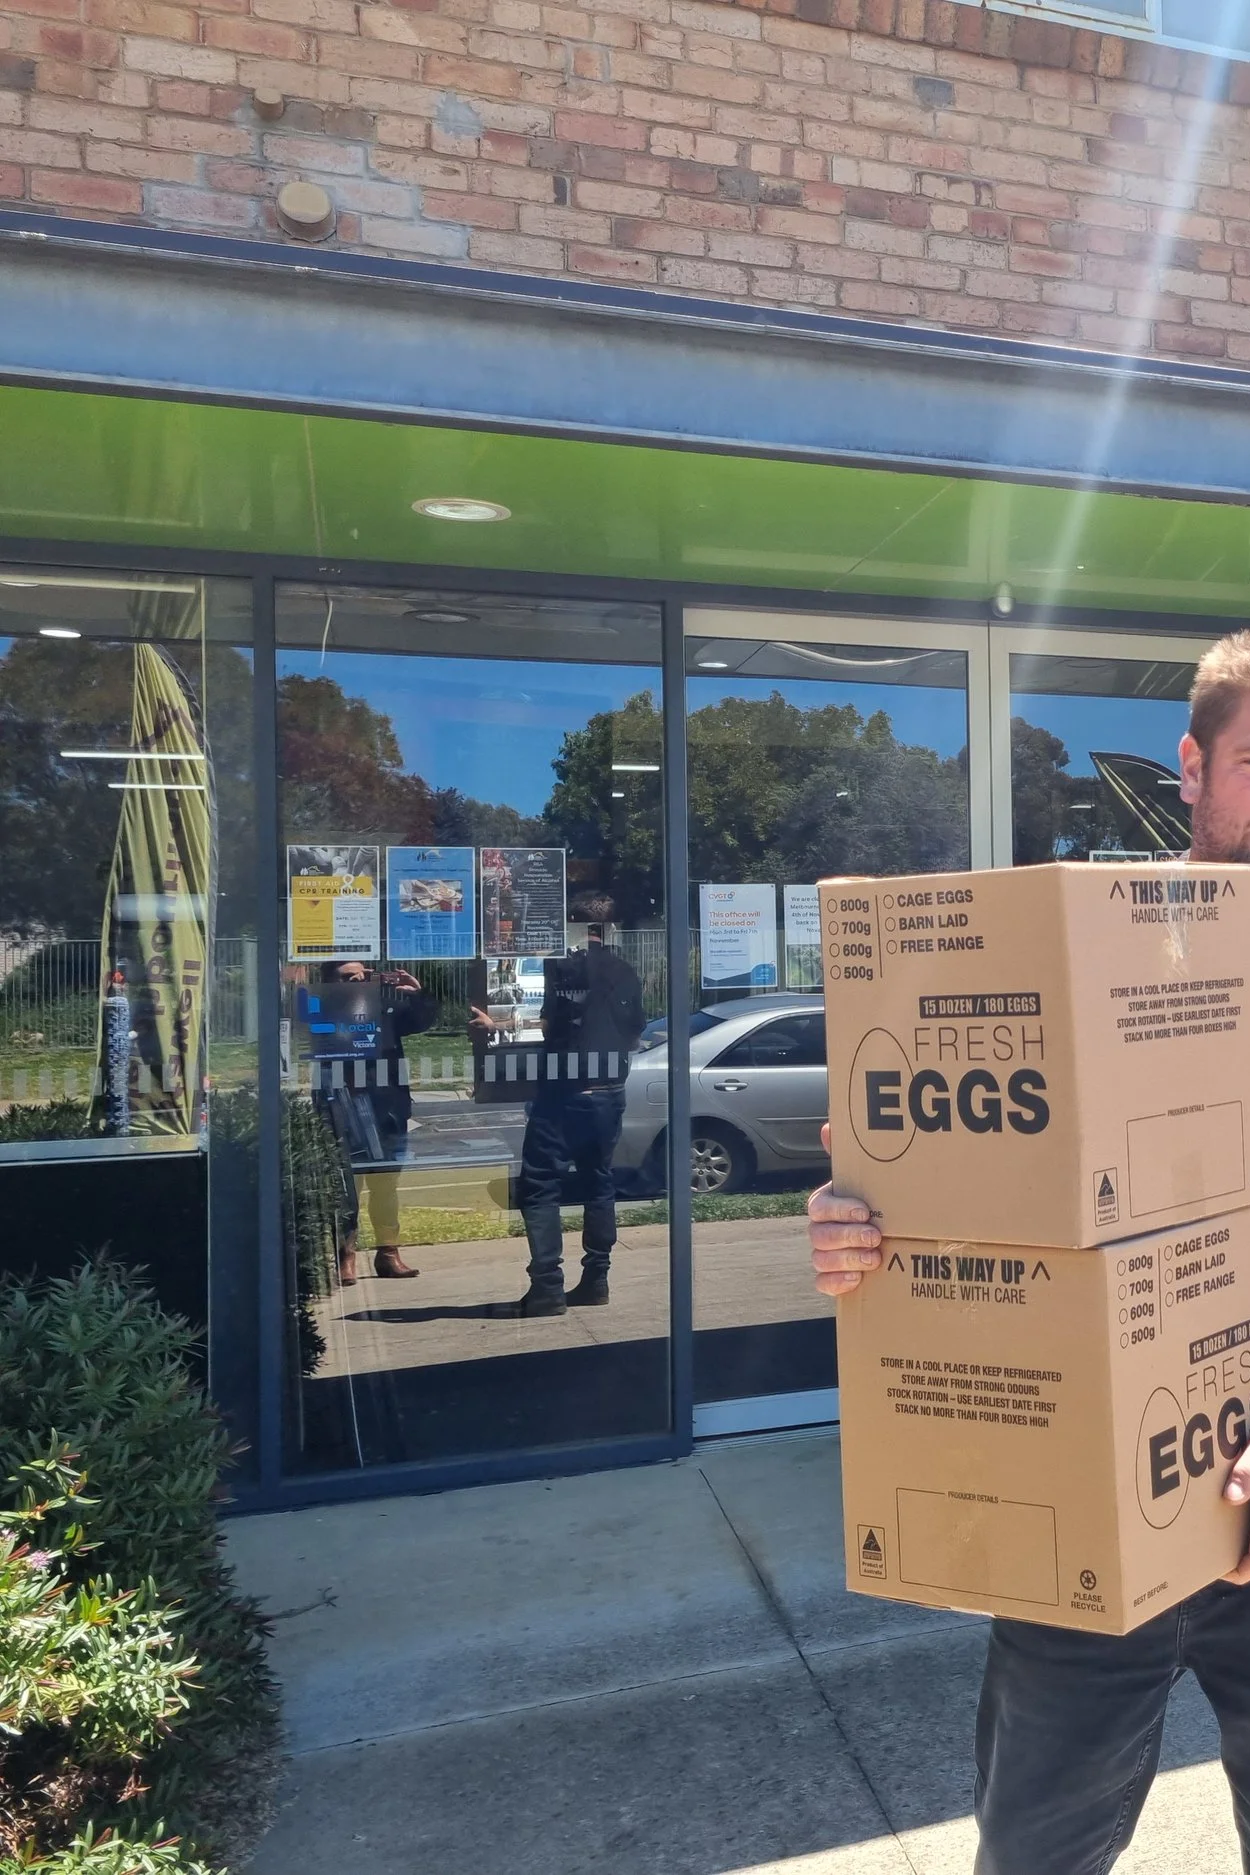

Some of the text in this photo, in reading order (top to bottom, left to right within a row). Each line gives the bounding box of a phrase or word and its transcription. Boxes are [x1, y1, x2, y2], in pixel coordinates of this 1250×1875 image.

[897, 889, 973, 908] CAGE EGGS
[1129, 880, 1218, 904] THIS WAY UP
[840, 898, 870, 913] 800g
[1131, 906, 1219, 923] HANDLE WITH CARE
[842, 920, 871, 936] 700g
[899, 913, 968, 931] BARN LAID
[843, 943, 872, 958] 600g
[900, 936, 984, 954] FREE RANGE
[844, 966, 873, 981] 500g
[1110, 977, 1244, 999] STORE IN A COOL PLACE OR KEEP REFRIGERATED
[923, 996, 1037, 1015] 15 DOZEN / 180 EGGS
[1128, 993, 1230, 1012] STORE AWAY FROM STRONG ODOURS
[1117, 1006, 1241, 1029] STOCK ROTATION USE EARLIEST DATE FIRST
[1124, 1020, 1237, 1043] STACK NO MORE THAN FOUR BOXES HIGH
[914, 1025, 1044, 1061] FRESH
[865, 1068, 1050, 1135] EGGS
[1175, 1228, 1230, 1257] CAGE EGGS
[911, 1254, 1025, 1284] THIS WAY UP
[1128, 1255, 1153, 1272] 800g
[1175, 1252, 1226, 1280] BARN LAID
[911, 1282, 1026, 1305] HANDLE WITH CARE
[1129, 1279, 1153, 1296] 700g
[1176, 1271, 1235, 1304] FREE RANGE
[1130, 1302, 1154, 1320] 600g
[1131, 1326, 1155, 1344] 500g
[1192, 1343, 1201, 1360] 15
[1203, 1333, 1227, 1355] DOZEN
[1233, 1325, 1248, 1344] 180
[880, 1357, 1062, 1383] STORE IN A COOL PLACE OR KEEP REFRIGERATED
[901, 1374, 1040, 1396] STORE AWAY FROM STRONG ODOURS
[886, 1388, 1057, 1413] STOCK ROTATION USE EARLIEST DATE FIRST
[895, 1403, 1049, 1428] STACK NO MORE THAN FOUR BOXES HIGH
[948, 1491, 976, 1501] PRODUCER
[1071, 1601, 1106, 1613] RECYCLE
[1073, 1592, 1103, 1603] PLEASE
[1133, 1593, 1146, 1607] BEST
